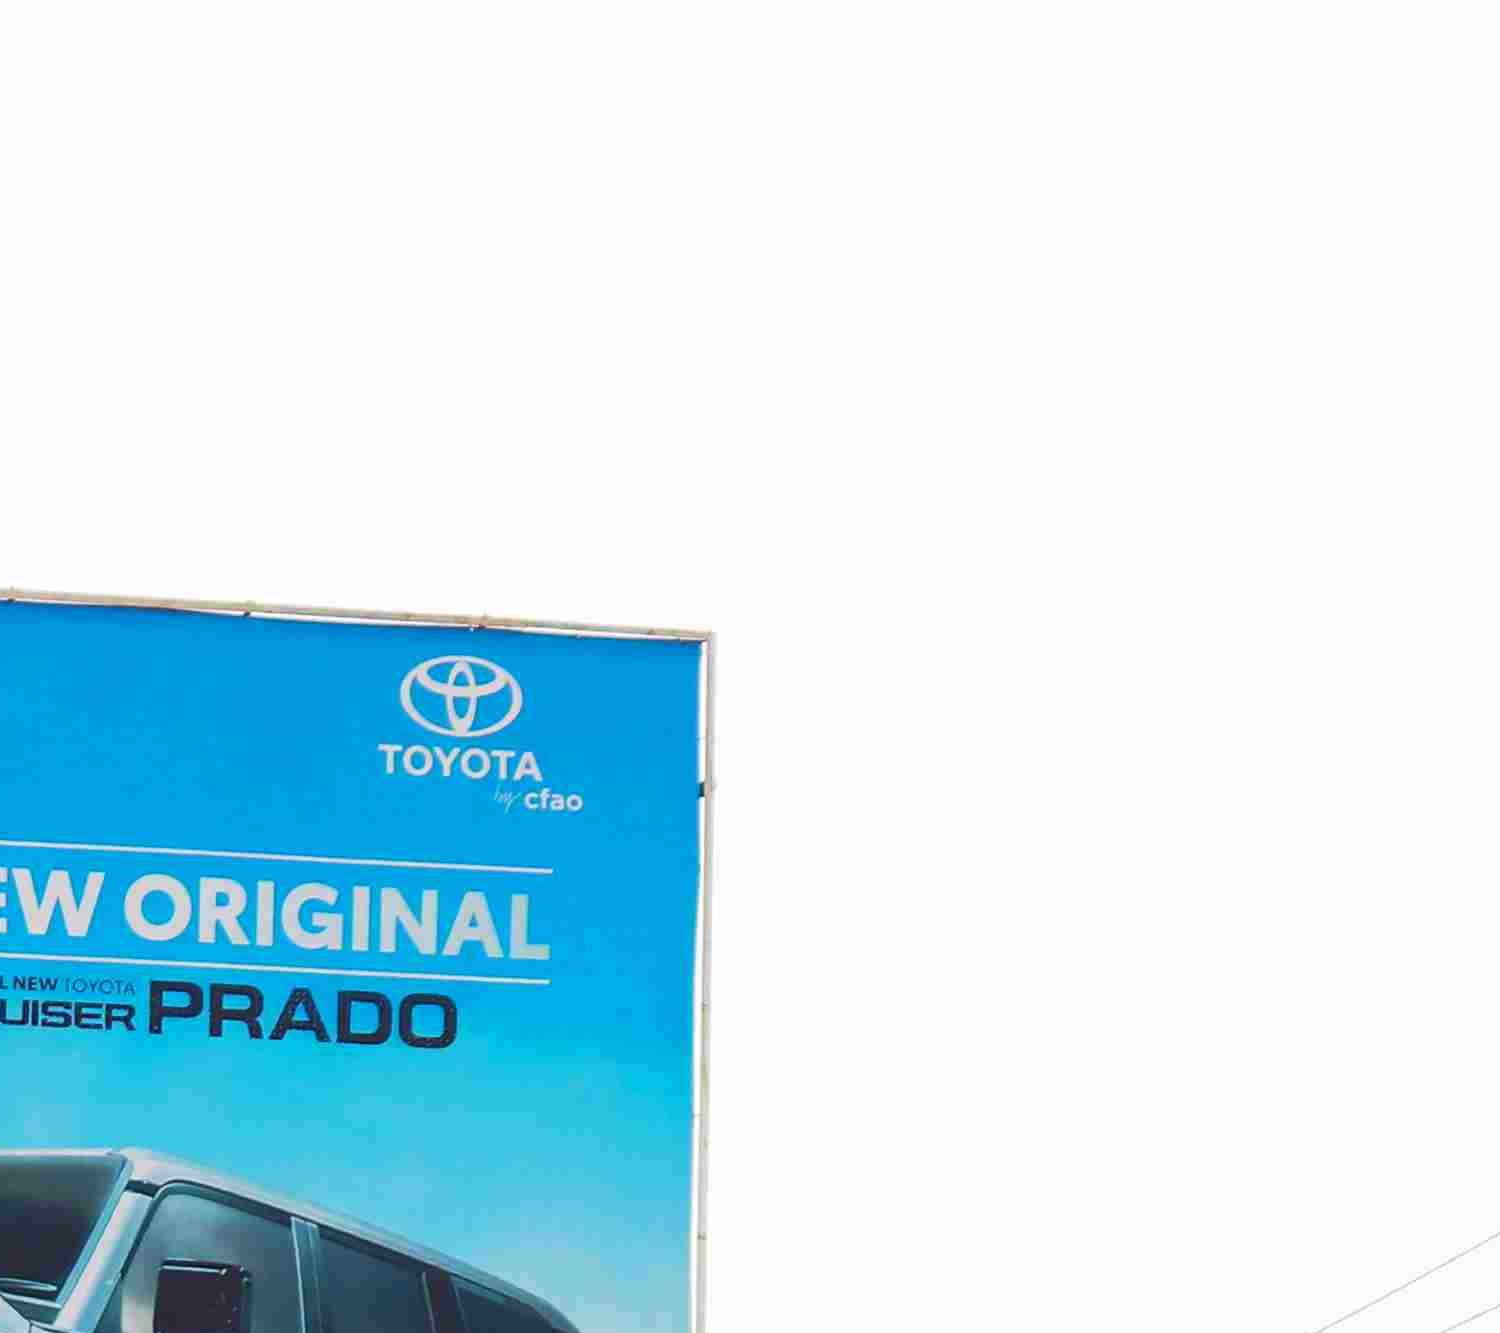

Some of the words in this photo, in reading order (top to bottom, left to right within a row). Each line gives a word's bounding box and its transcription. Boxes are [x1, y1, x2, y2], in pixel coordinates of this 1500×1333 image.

[377, 743, 543, 781] TOYOTA
[524, 787, 583, 812] cfao
[123, 874, 550, 961] ORIGINAL
[12, 976, 58, 992] NEW
[64, 978, 137, 996] TOYOTA
[147, 980, 458, 1050] PRADO
